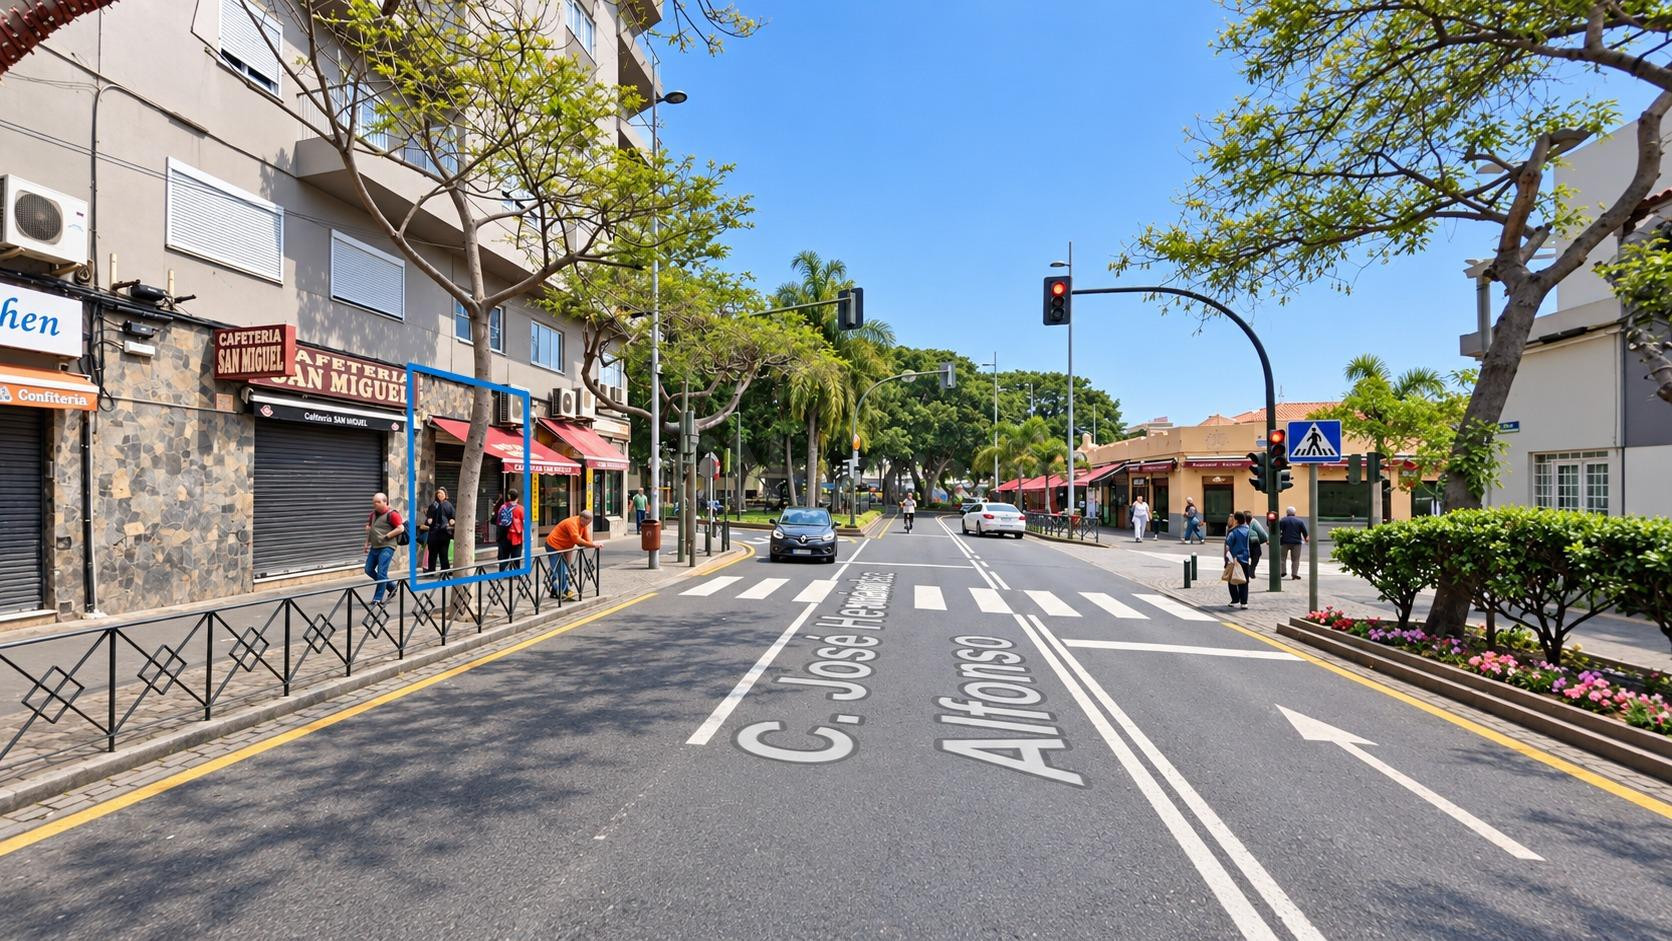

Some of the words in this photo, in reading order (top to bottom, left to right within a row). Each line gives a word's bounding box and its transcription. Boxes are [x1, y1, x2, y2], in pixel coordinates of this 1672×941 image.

[0, 297, 60, 336] hen
[218, 329, 282, 346] CAFETERIA
[217, 348, 240, 374] SAN
[241, 345, 284, 373] MIGUEL
[295, 349, 407, 384] AFETERIA
[270, 363, 324, 390] AN
[18, 389, 88, 406] Confiteria
